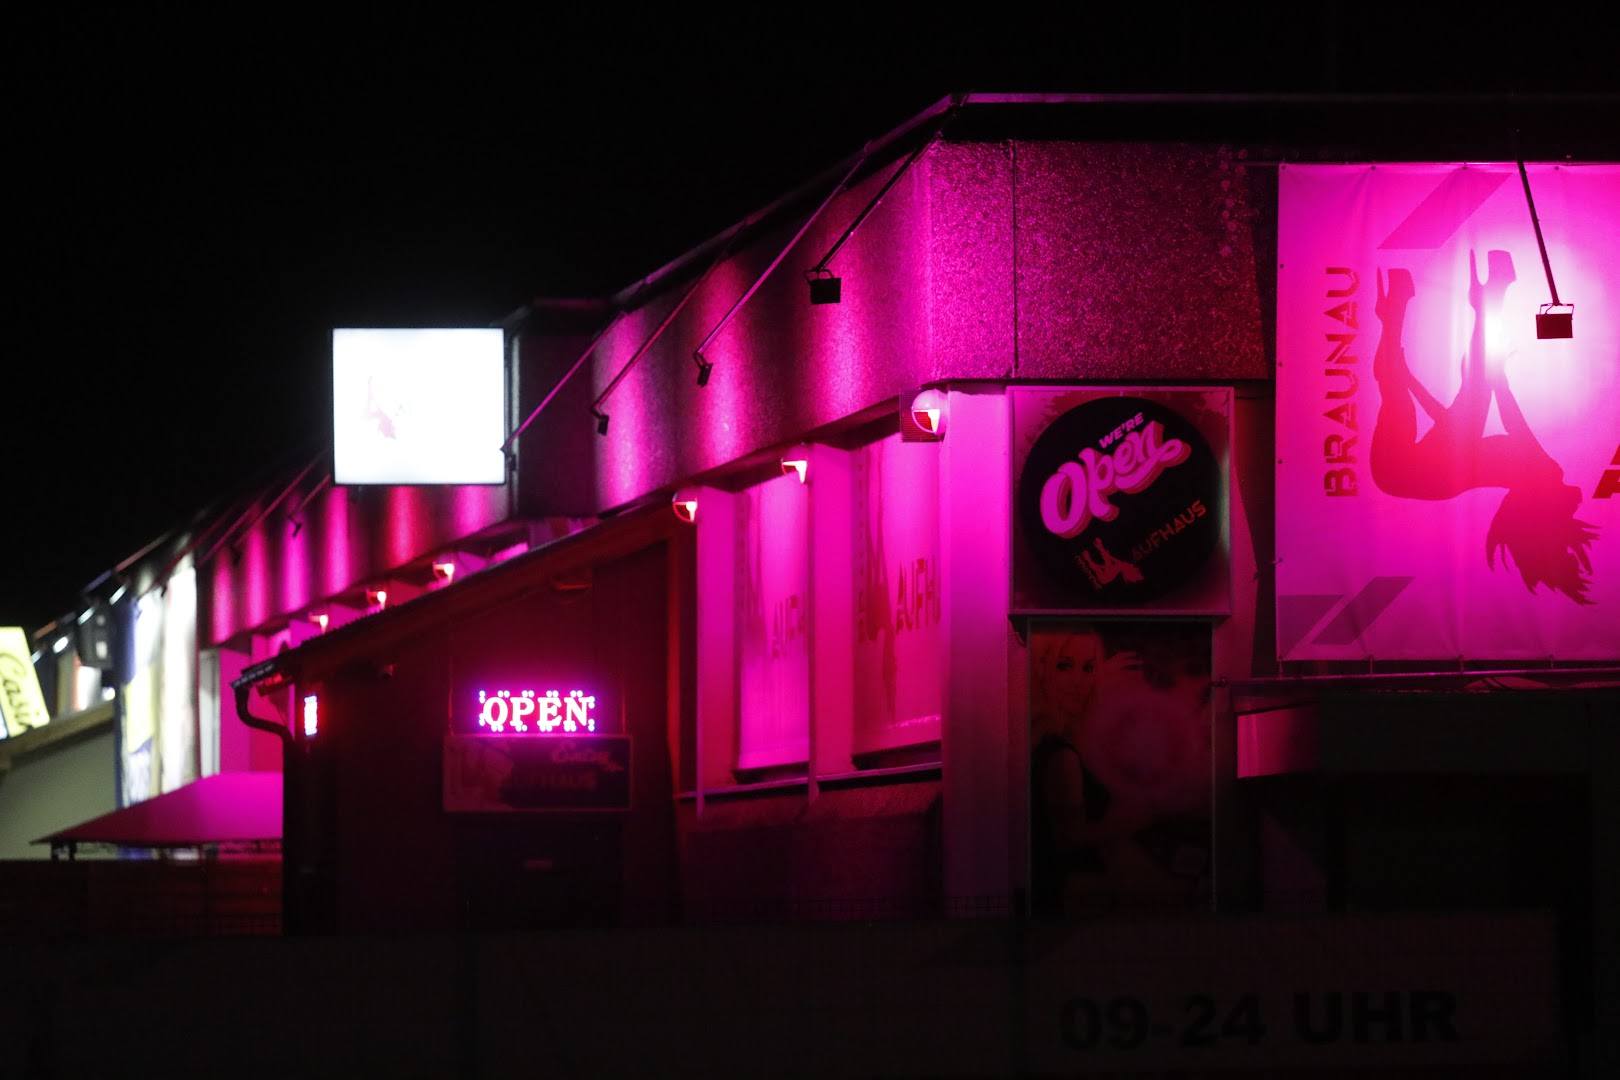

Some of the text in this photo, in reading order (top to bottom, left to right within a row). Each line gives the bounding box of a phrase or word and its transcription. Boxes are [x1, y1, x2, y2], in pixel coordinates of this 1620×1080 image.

[1324, 267, 1359, 497] BRAUNAU
[1099, 411, 1144, 449] WE'RE
[1040, 420, 1191, 539] Open
[481, 695, 594, 729] OPEN
[1294, 990, 1459, 1044] UHR
